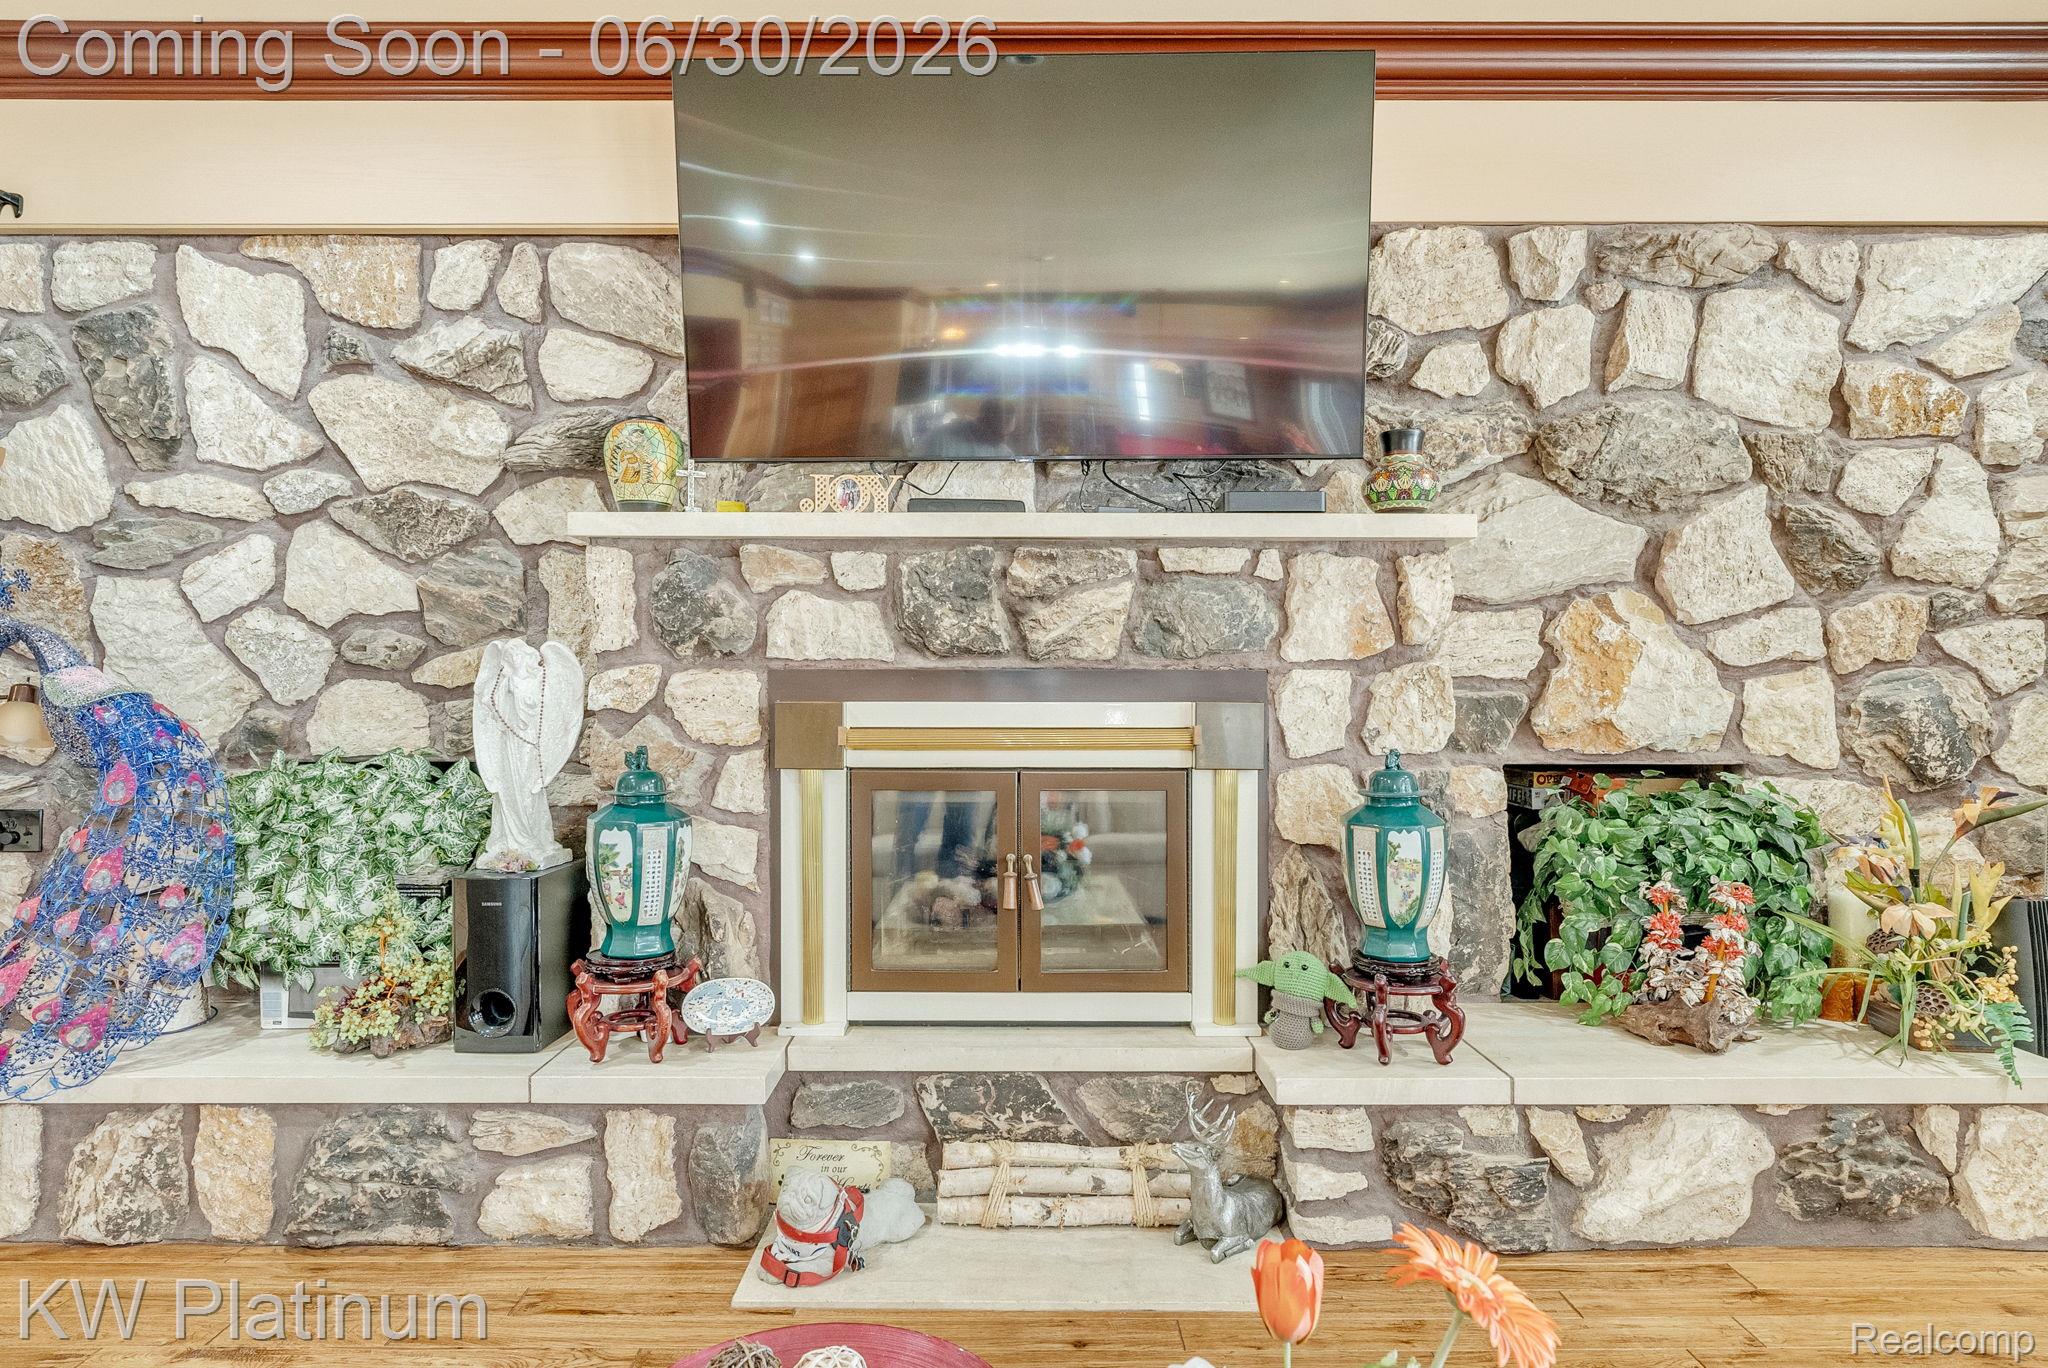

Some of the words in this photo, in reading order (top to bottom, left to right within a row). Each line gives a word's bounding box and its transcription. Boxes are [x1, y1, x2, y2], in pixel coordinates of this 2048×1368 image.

[800, 474, 903, 512] JOY
[796, 1145, 845, 1162] Forever
[821, 1163, 830, 1173] in
